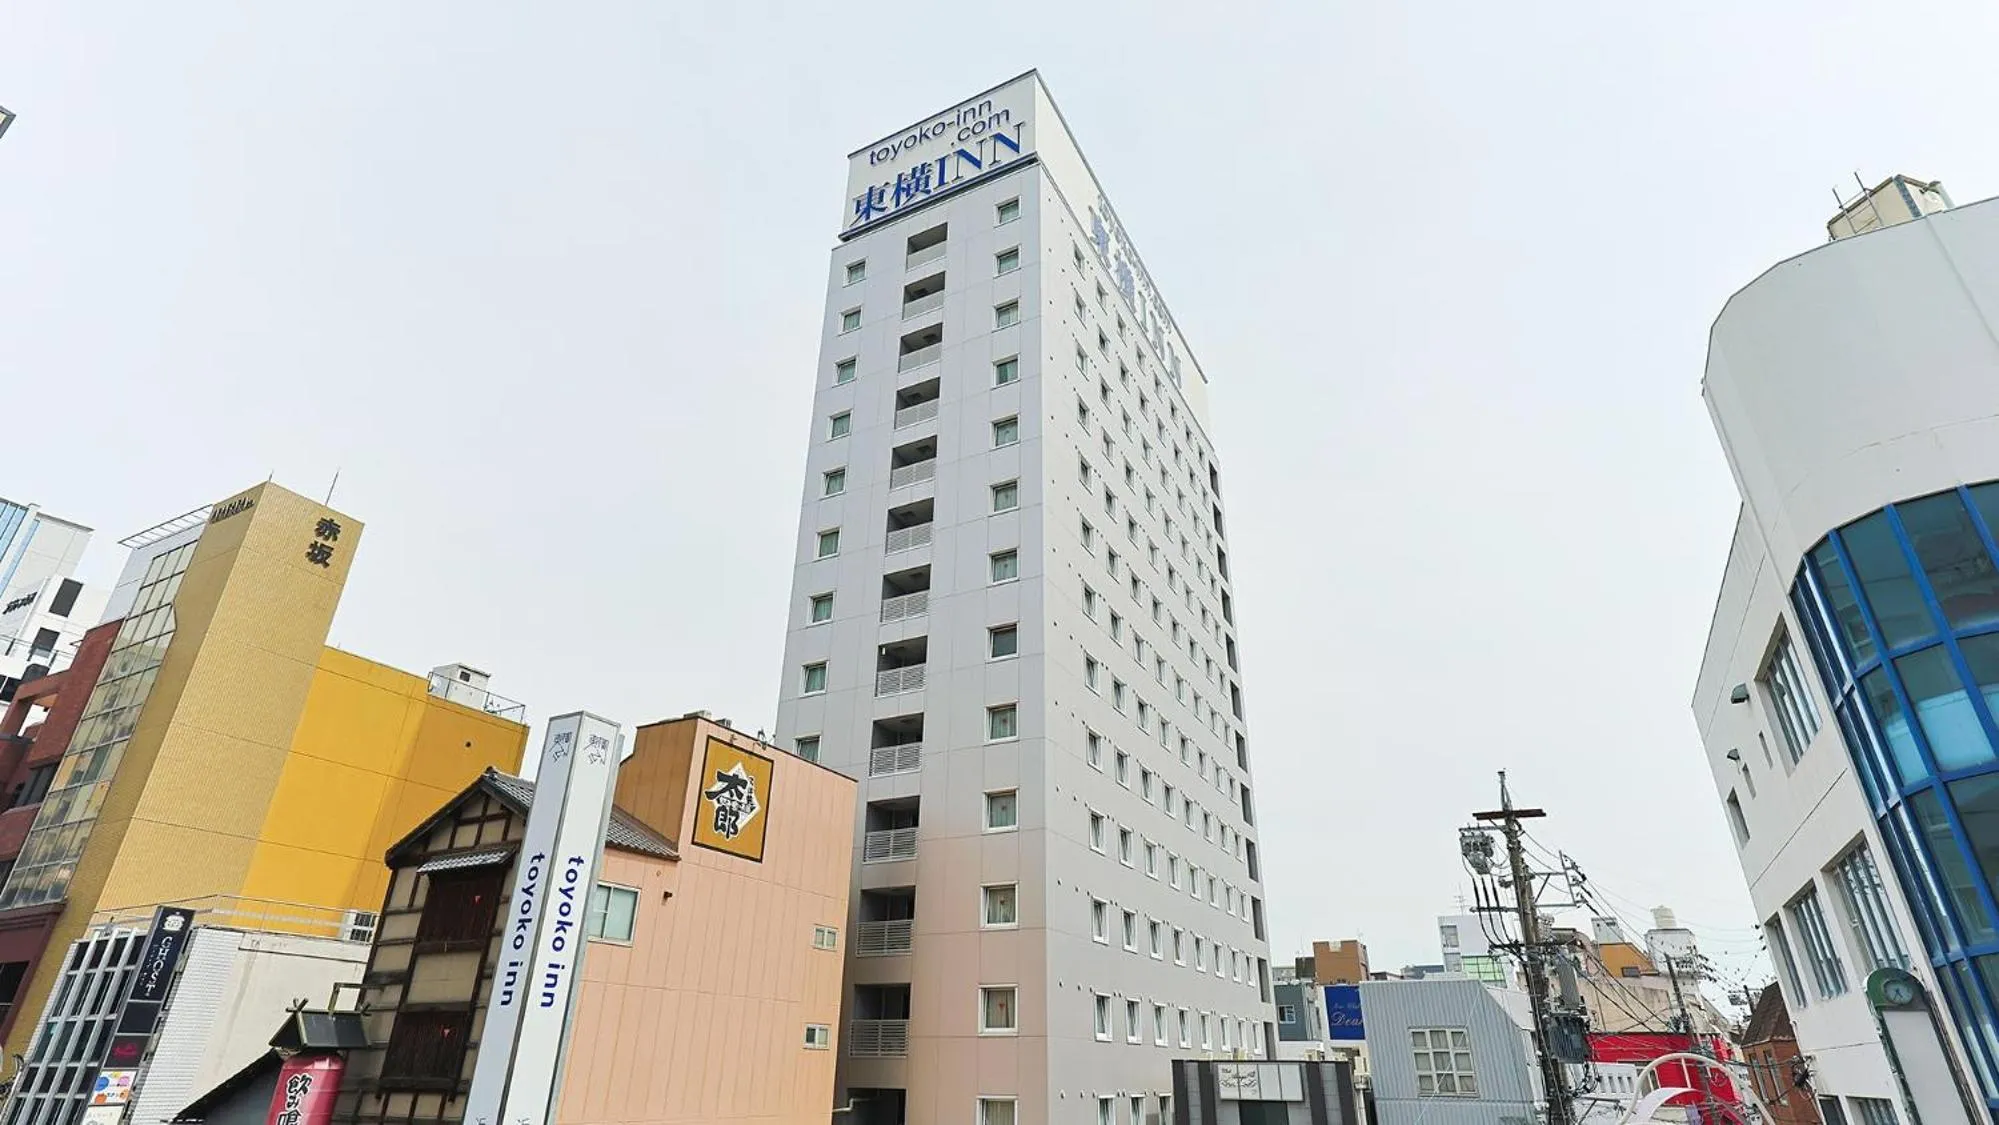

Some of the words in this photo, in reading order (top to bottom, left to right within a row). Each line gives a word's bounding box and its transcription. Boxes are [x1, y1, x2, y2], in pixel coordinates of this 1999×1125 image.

[869, 100, 992, 167] toyoko-inn
[950, 109, 1010, 147] .com
[850, 121, 1025, 227] 東横INN
[1088, 205, 1182, 390] INN
[305, 516, 341, 569] 赤坂
[704, 770, 749, 839] 太郎
[512, 852, 545, 950] toyoko
[552, 855, 584, 952] toyoko
[145, 936, 173, 997] GHOST
[500, 960, 523, 1006] inn
[540, 963, 565, 1008] inn
